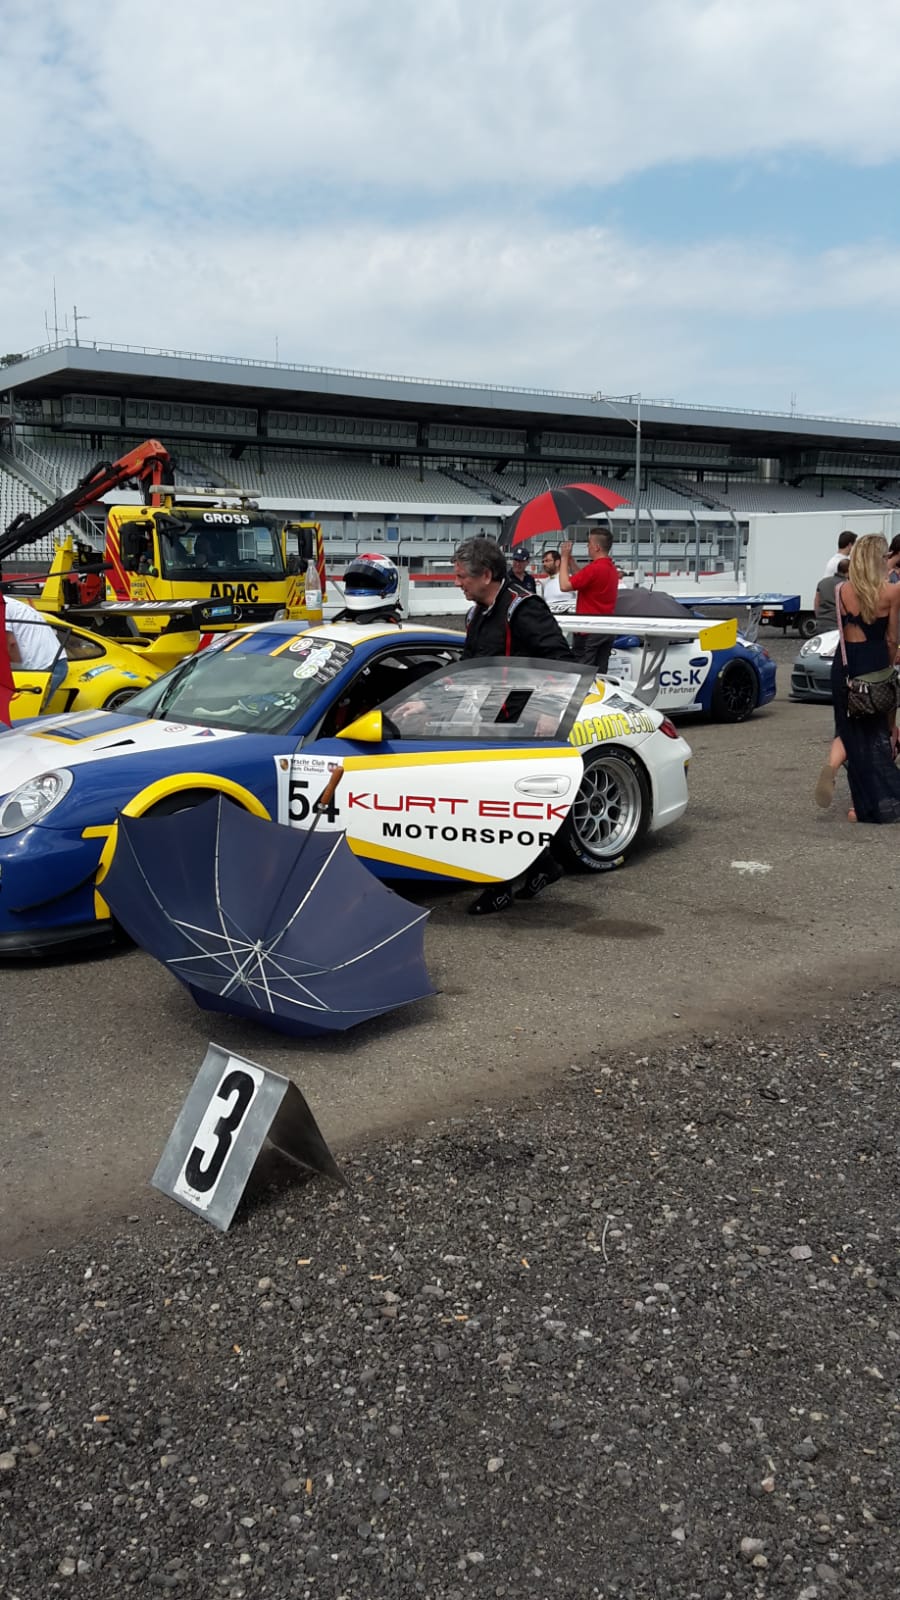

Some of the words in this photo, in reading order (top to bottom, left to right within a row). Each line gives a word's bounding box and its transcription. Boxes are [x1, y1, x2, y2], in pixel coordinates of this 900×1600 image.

[203, 512, 250, 525] GROSS
[210, 583, 259, 603] ADAC
[659, 669, 702, 687] CS-K
[669, 686, 696, 694] Partner
[289, 780, 340, 823] 54
[348, 791, 469, 815] KURT
[478, 800, 569, 820] ECK
[382, 822, 553, 848] MOTORSPOR
[185, 1070, 255, 1193] 3
